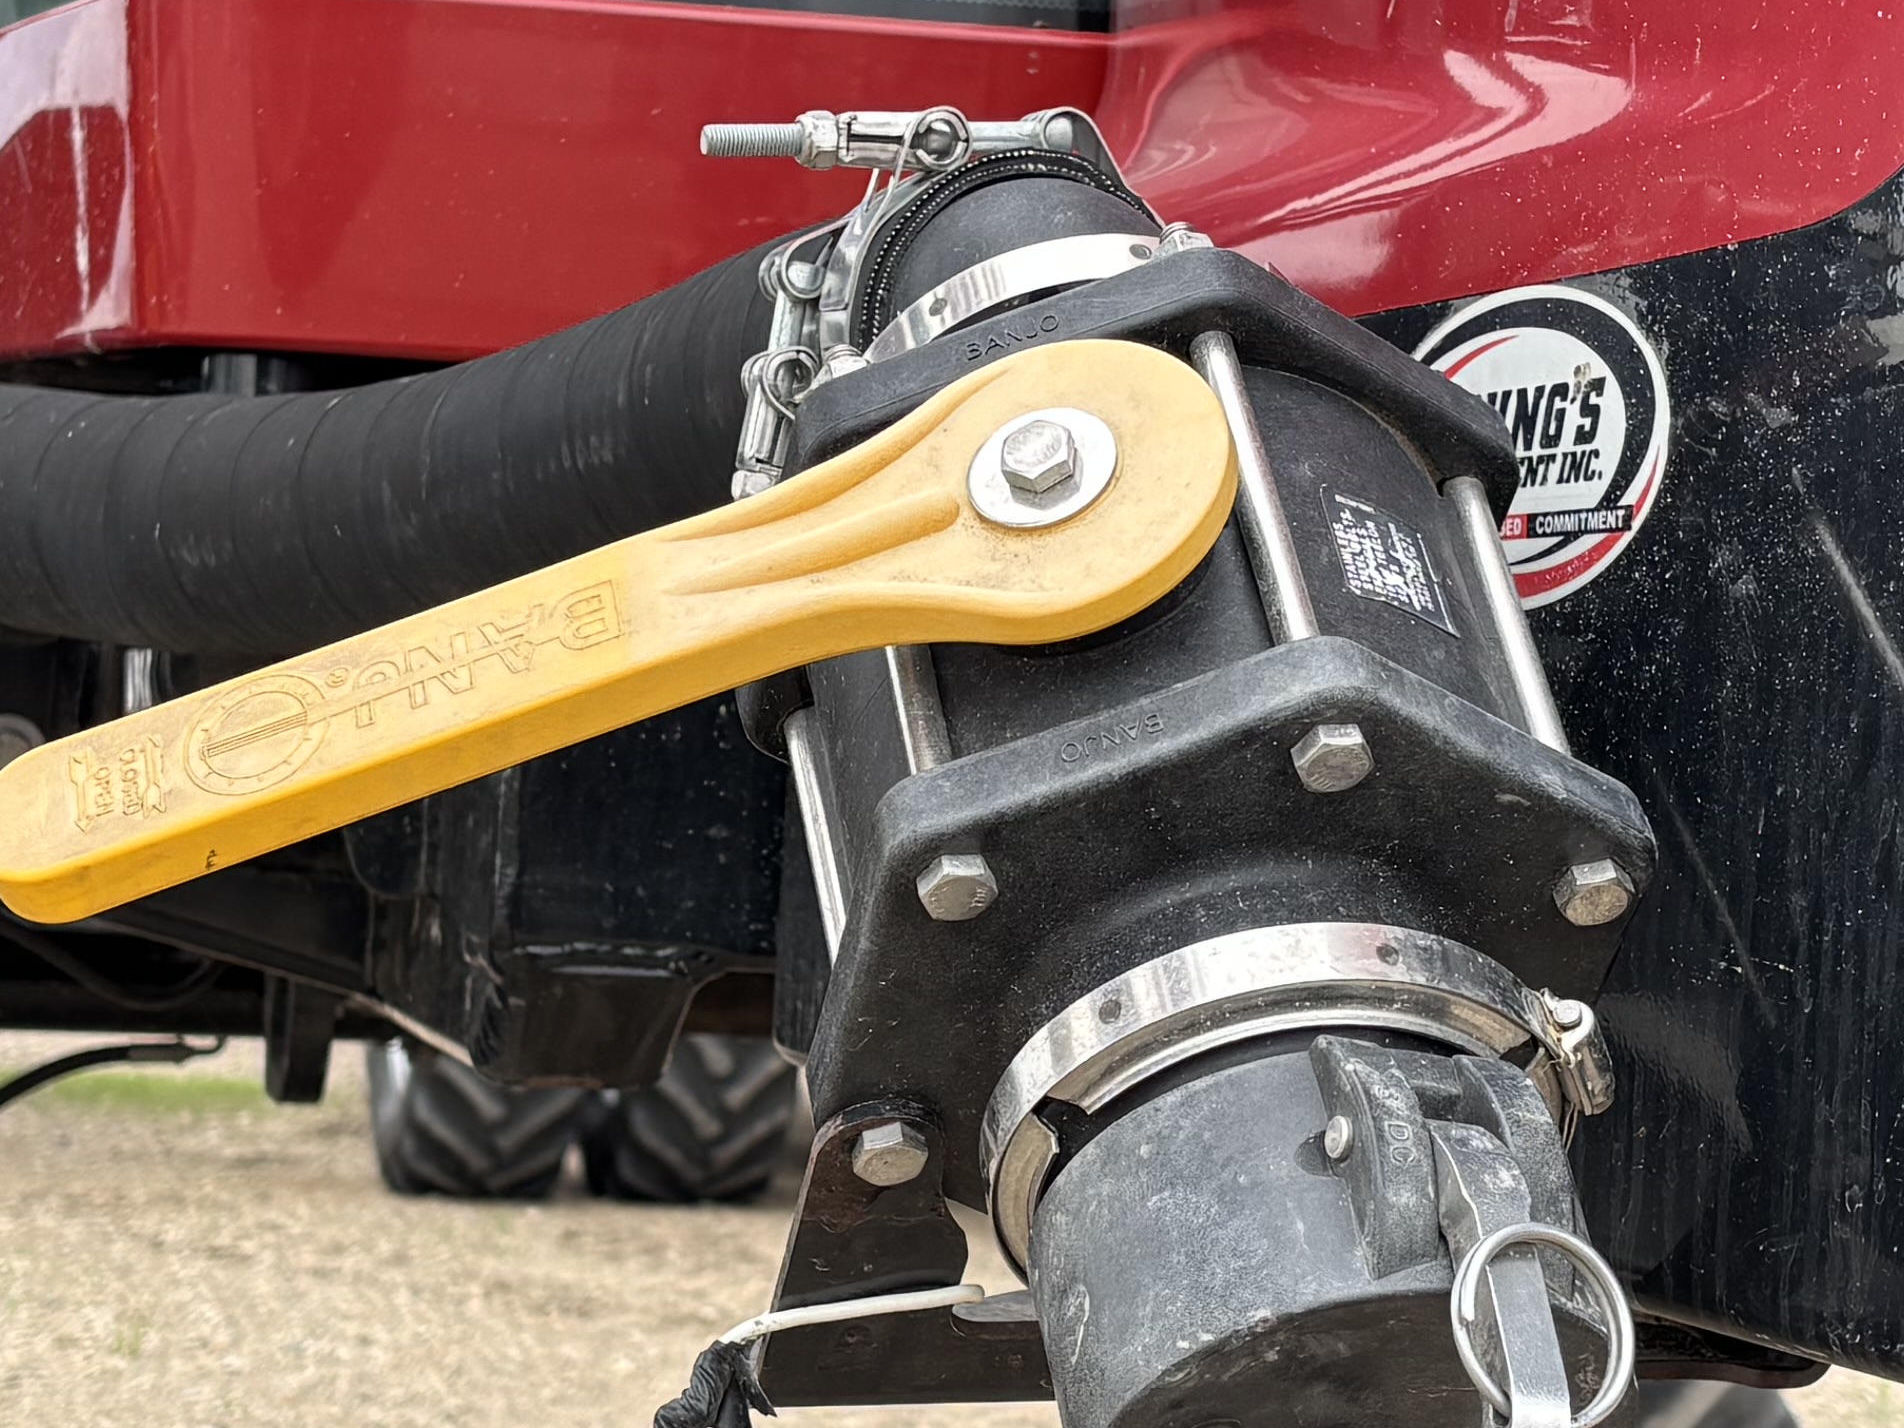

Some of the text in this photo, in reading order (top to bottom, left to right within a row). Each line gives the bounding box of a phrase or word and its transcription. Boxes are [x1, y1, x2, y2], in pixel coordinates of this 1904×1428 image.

[965, 314, 1061, 362] BANJO
[1556, 448, 1603, 484] INC.
[1535, 509, 1626, 534] COMMITMENT
[1060, 713, 1165, 763] BANJO
